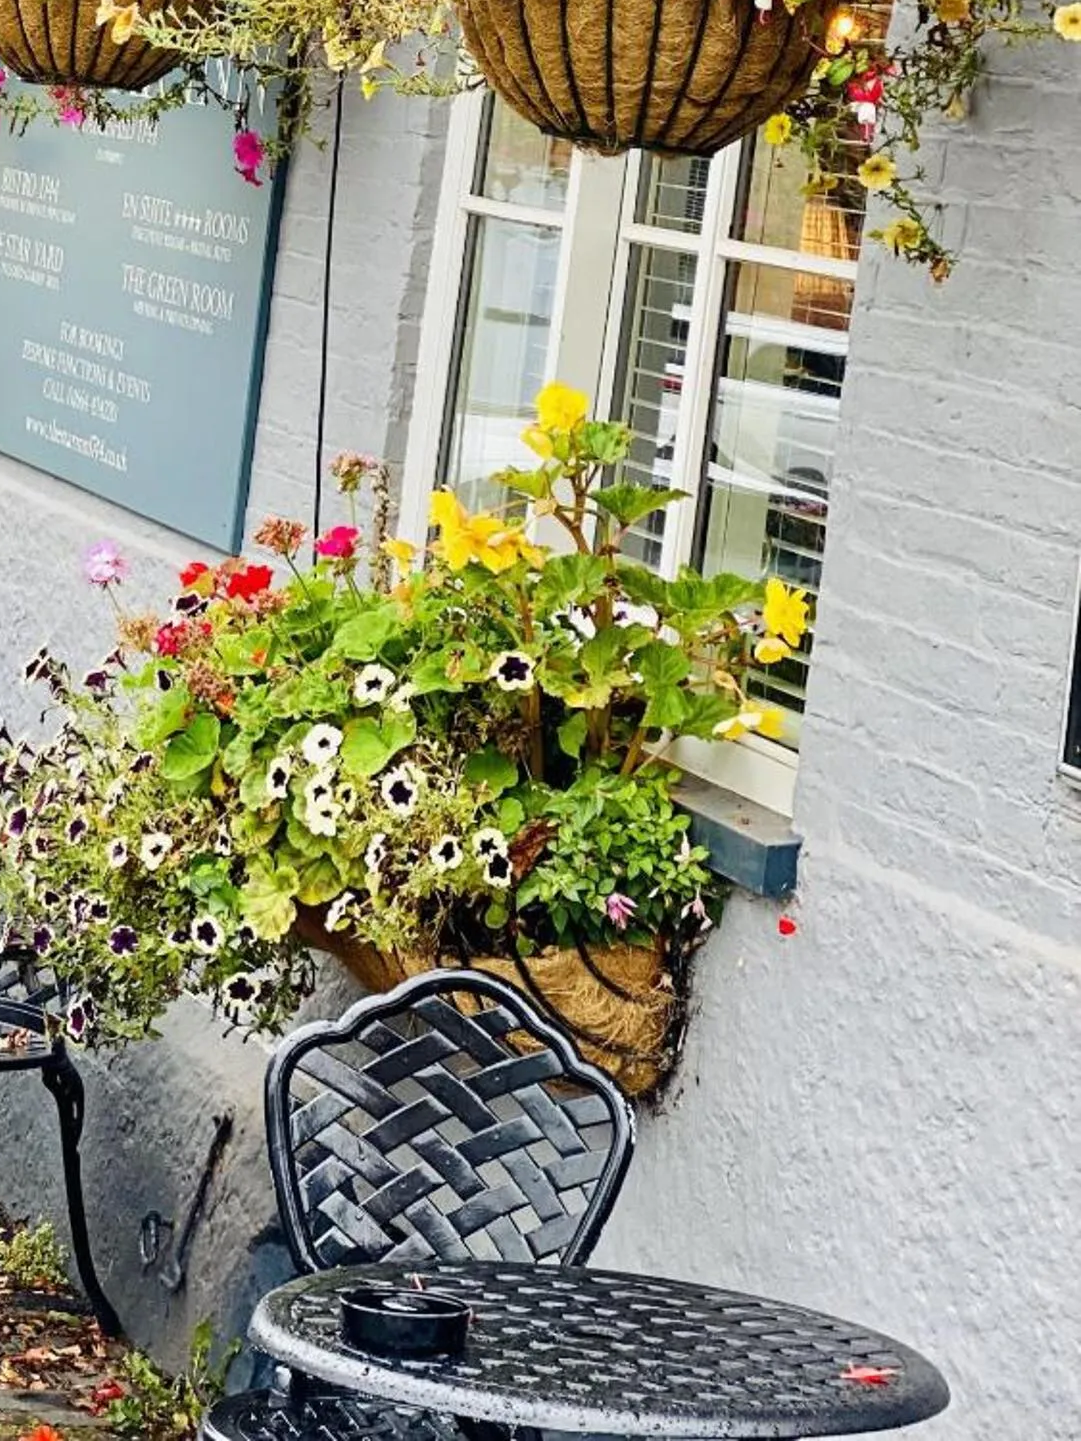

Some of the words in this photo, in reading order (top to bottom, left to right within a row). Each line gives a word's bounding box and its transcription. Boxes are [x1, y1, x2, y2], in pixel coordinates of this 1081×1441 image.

[203, 208, 251, 245] ROOMS
[33, 240, 64, 273] YARD
[121, 263, 146, 296] THE
[146, 270, 190, 308] GREEN
[191, 281, 235, 321] ROOM
